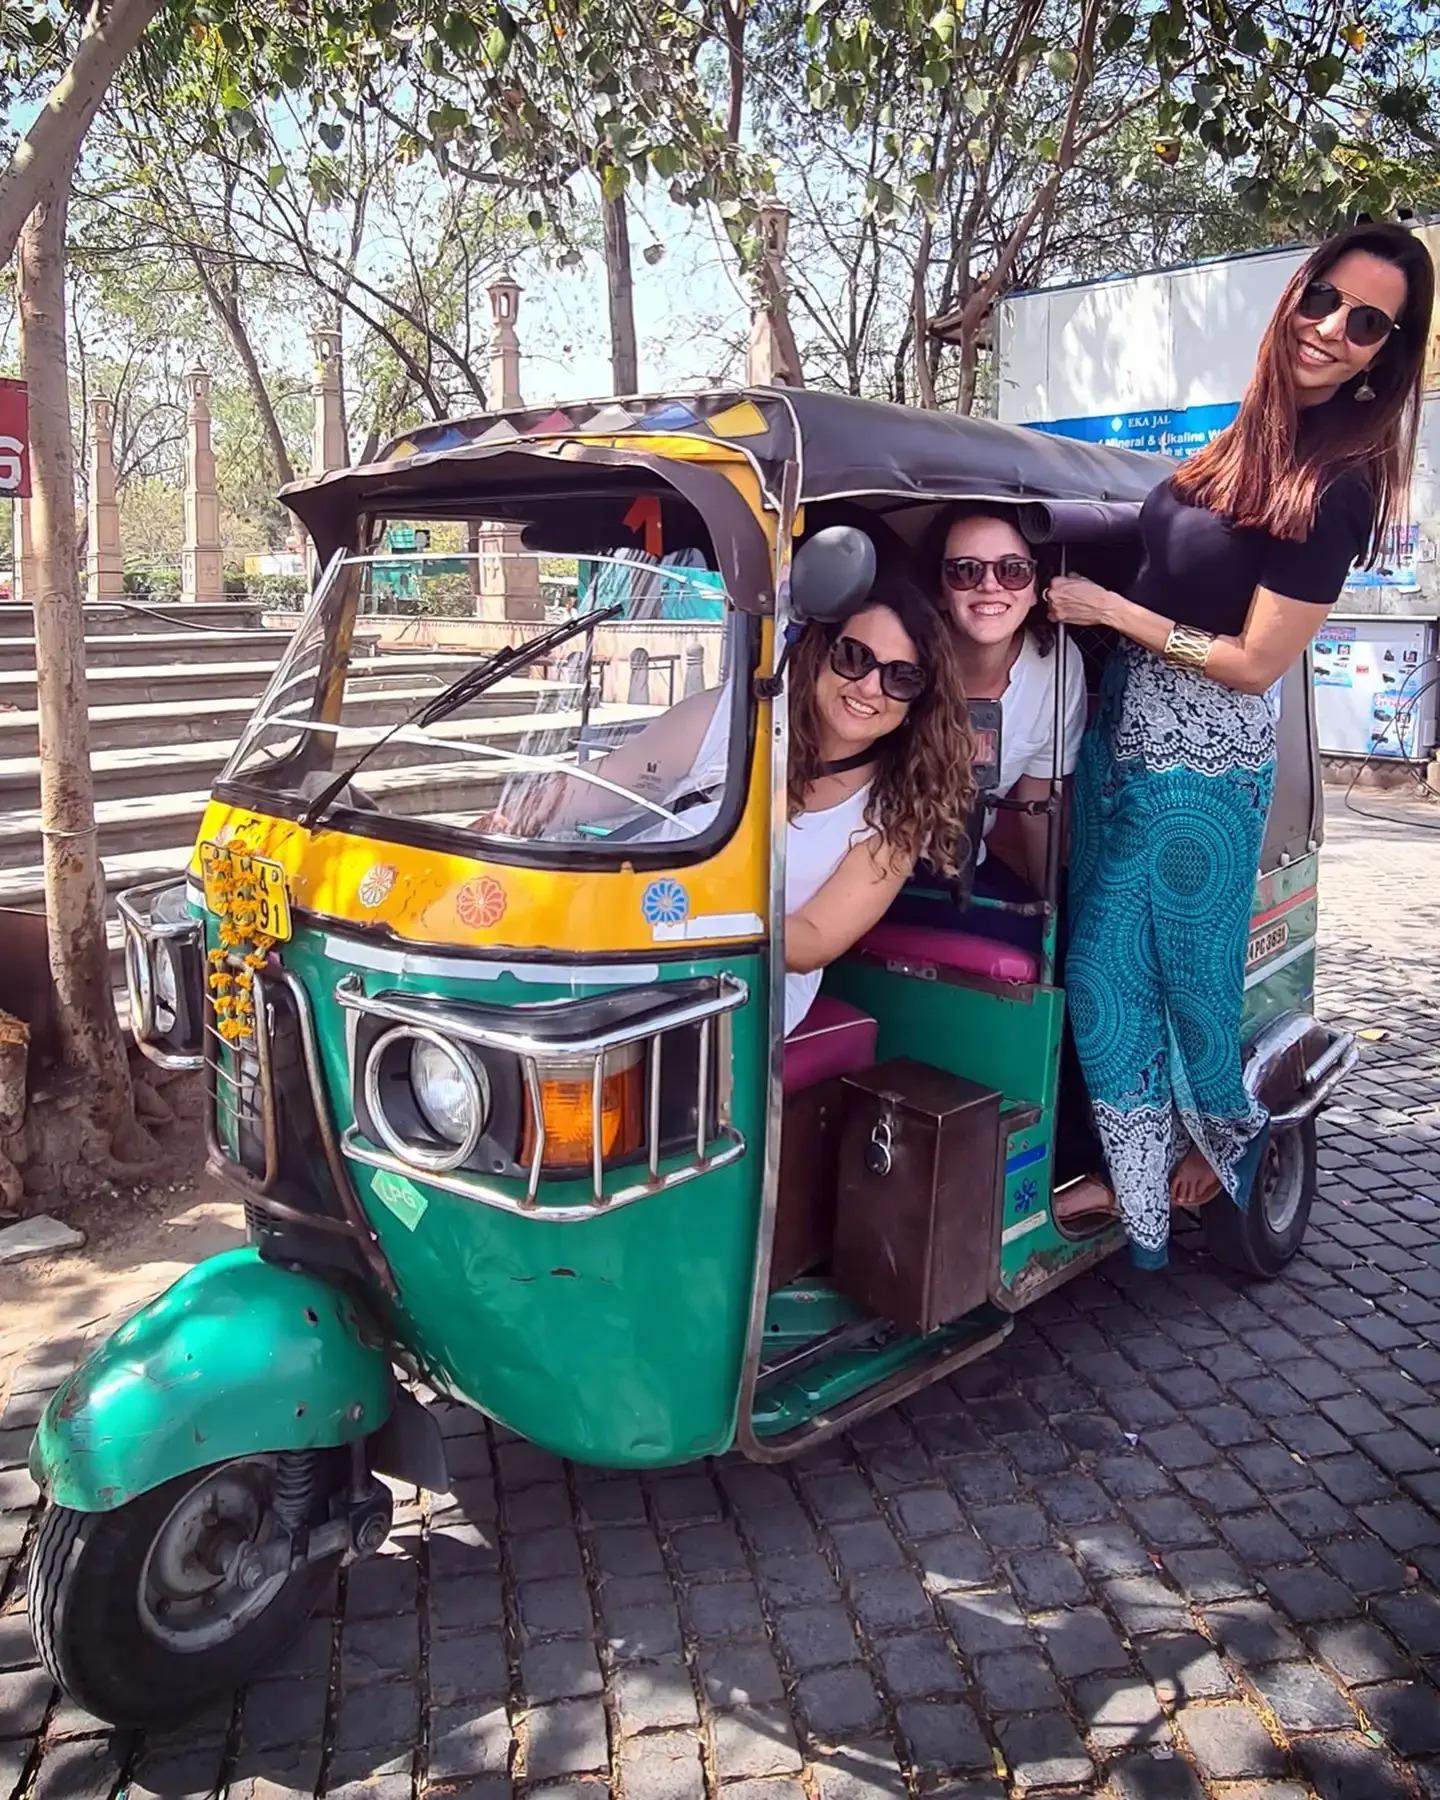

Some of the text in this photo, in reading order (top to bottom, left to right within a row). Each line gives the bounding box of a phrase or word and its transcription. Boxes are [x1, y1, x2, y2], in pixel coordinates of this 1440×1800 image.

[1127, 414, 1172, 429] EKA JAL
[1147, 434, 1156, 446] &
